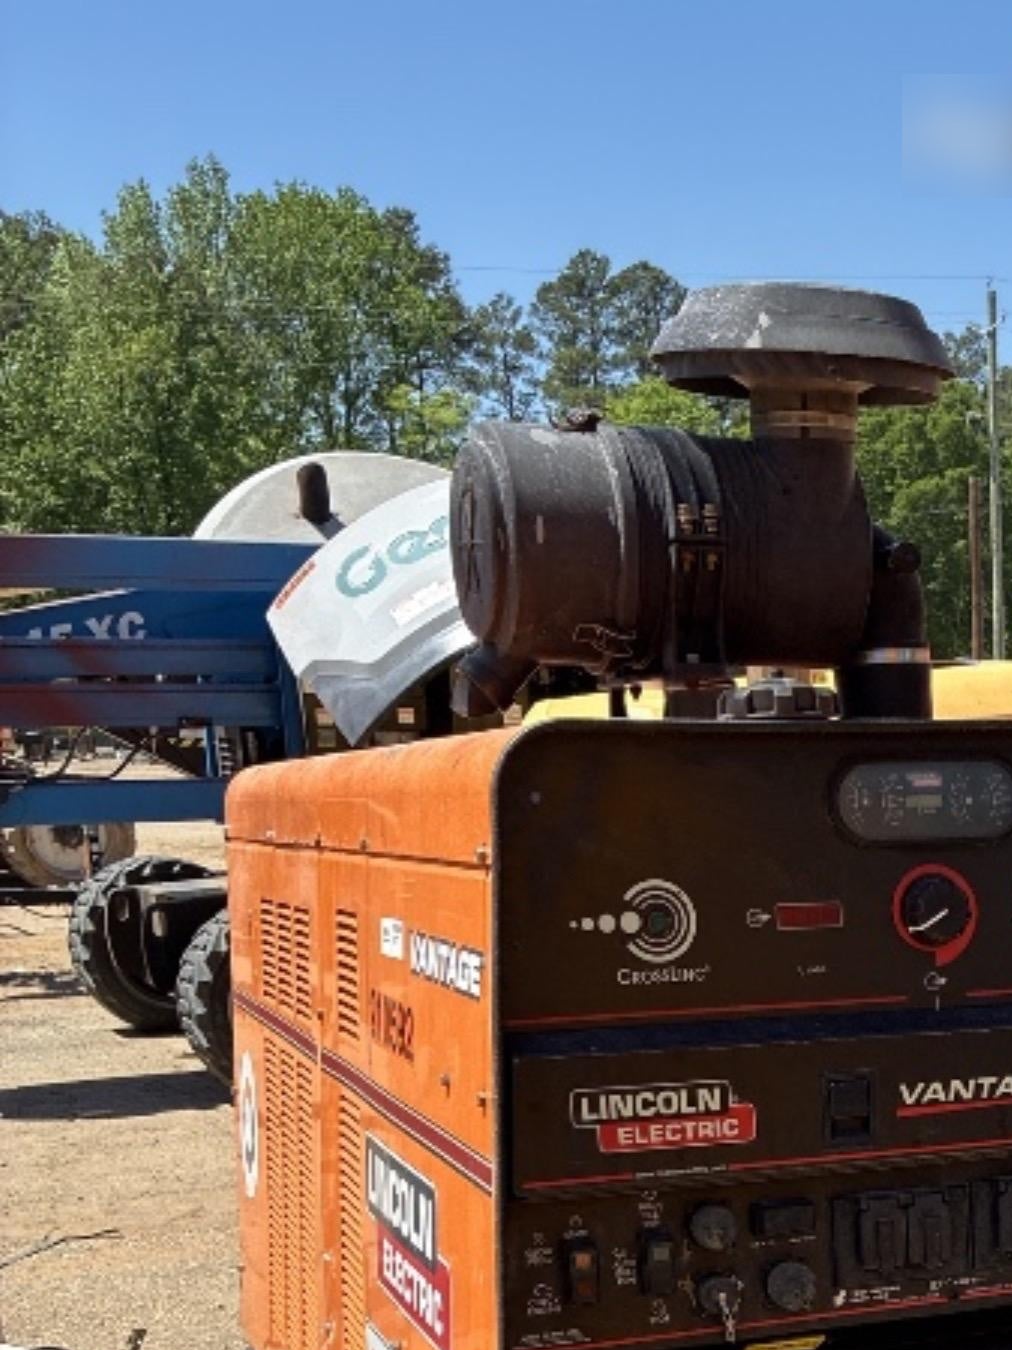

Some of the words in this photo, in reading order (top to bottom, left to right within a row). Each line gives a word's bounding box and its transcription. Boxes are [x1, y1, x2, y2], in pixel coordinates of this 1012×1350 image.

[409, 933, 482, 999] VANTAGE
[580, 1086, 722, 1121] LINCOLN
[617, 1118, 739, 1146] ELECTRIC
[367, 1147, 434, 1262] LINCOLN
[382, 1237, 445, 1338] ELECTRIC
